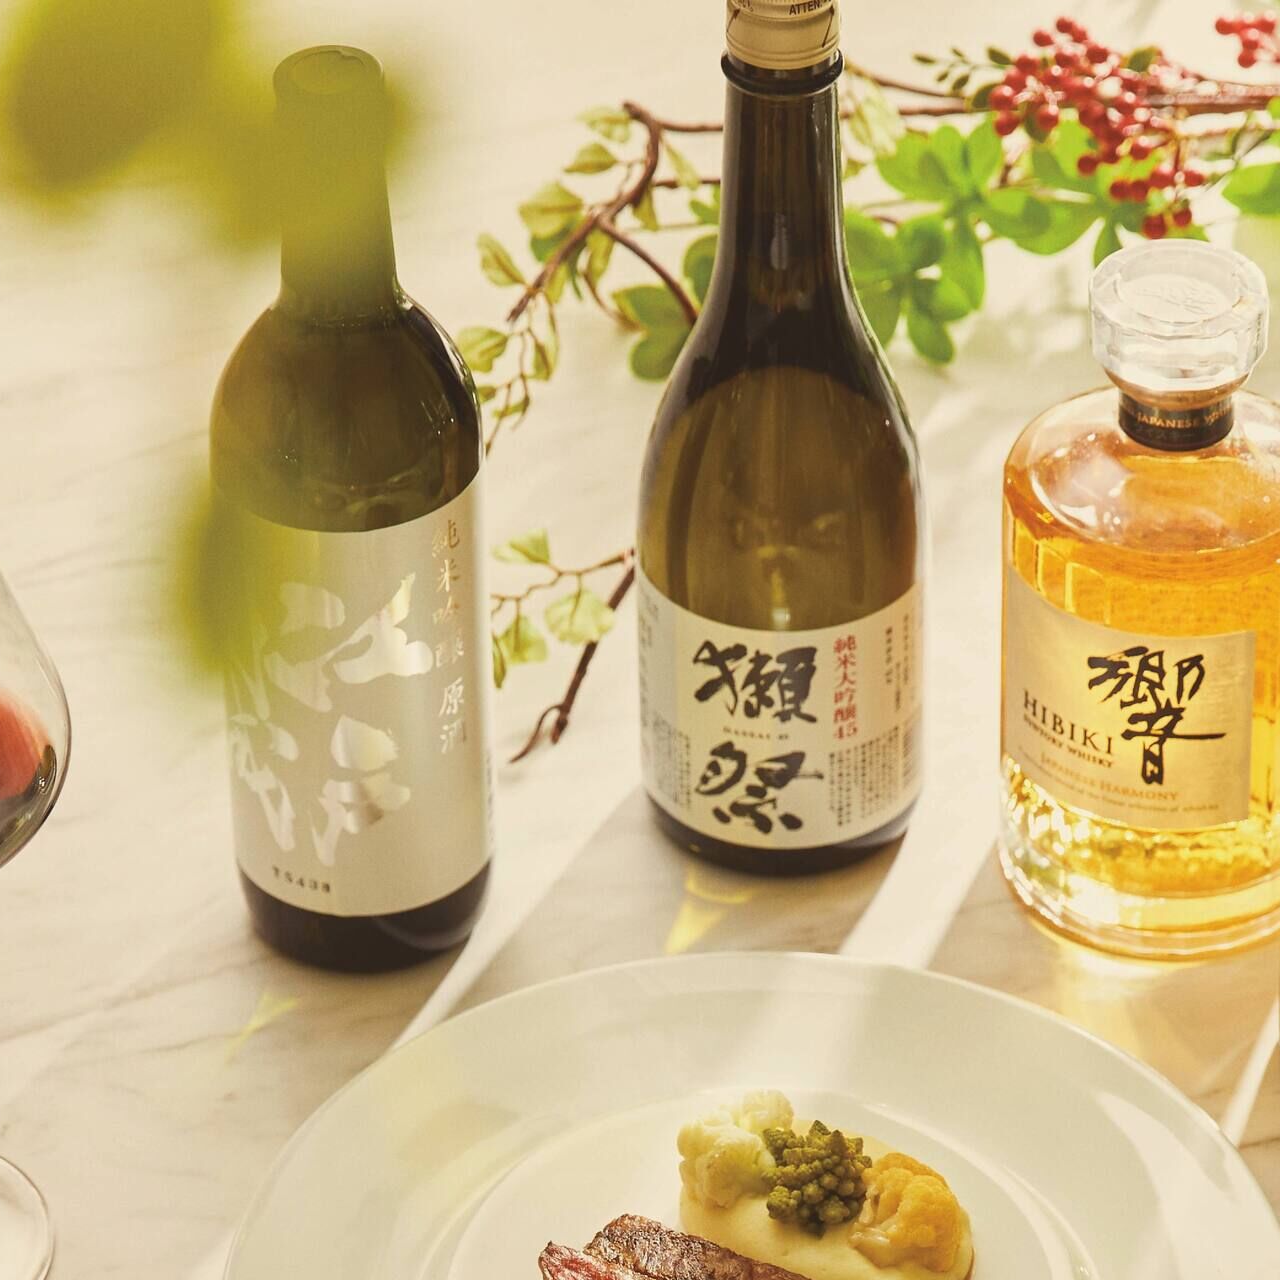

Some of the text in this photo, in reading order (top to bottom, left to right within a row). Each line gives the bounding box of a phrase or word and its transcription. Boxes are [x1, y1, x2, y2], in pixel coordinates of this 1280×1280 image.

[692, 640, 824, 834] 獺祭
[1023, 688, 1112, 755] HIBIKI
[1087, 645, 1227, 786] 響
